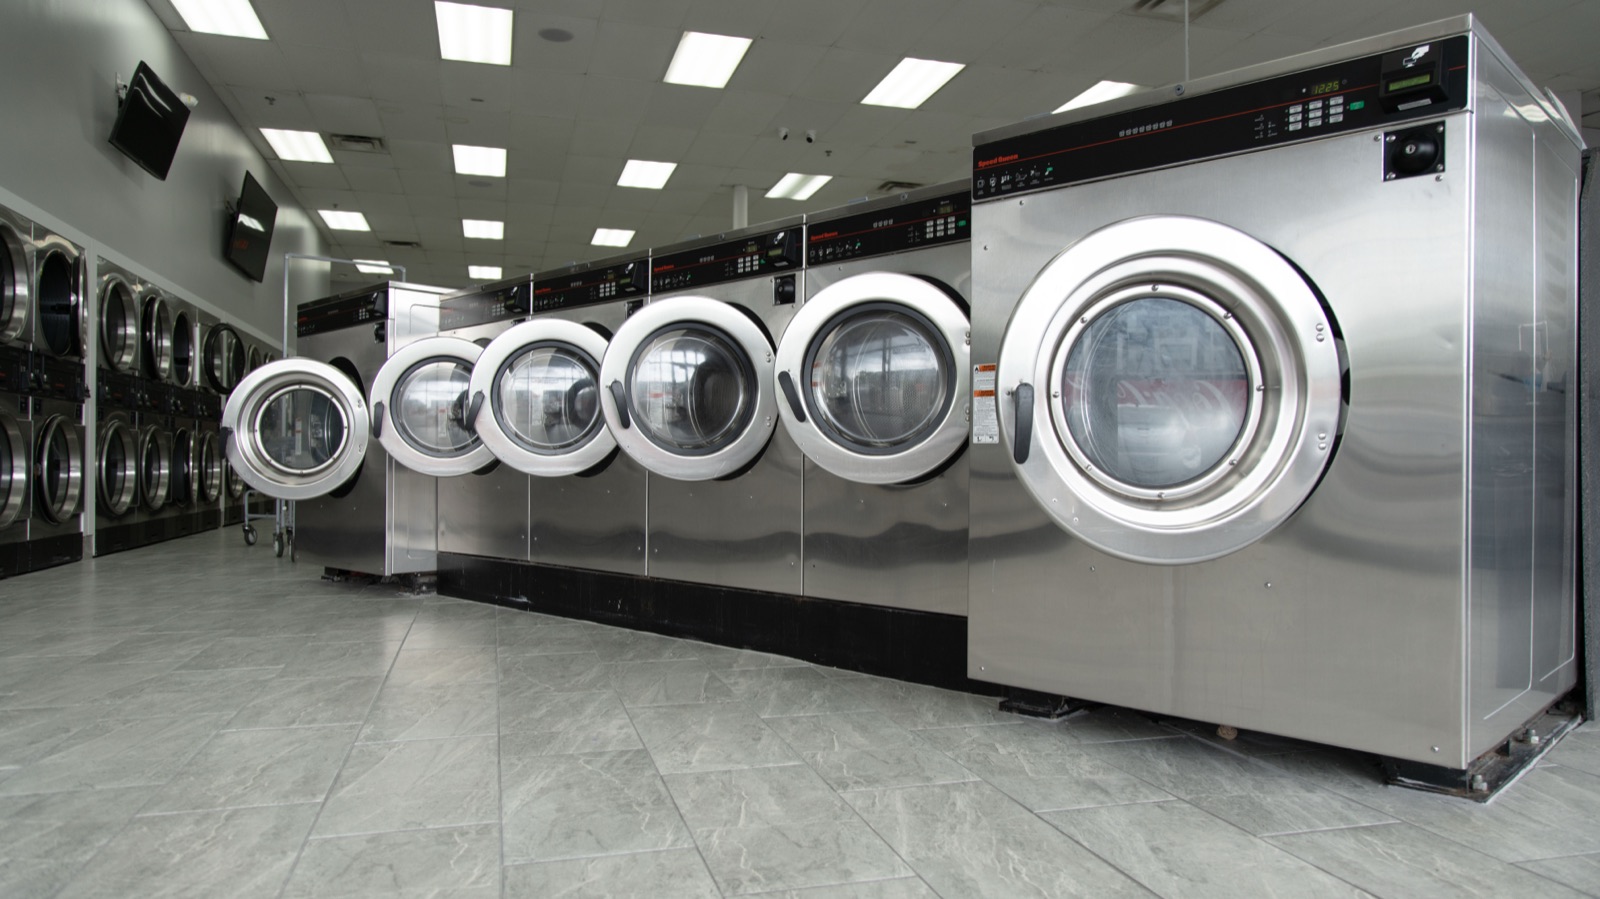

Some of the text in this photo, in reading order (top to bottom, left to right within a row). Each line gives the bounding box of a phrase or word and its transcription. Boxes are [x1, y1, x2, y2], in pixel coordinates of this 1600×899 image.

[1313, 81, 1339, 95] 1225
[978, 154, 1019, 167] Speed Queen
